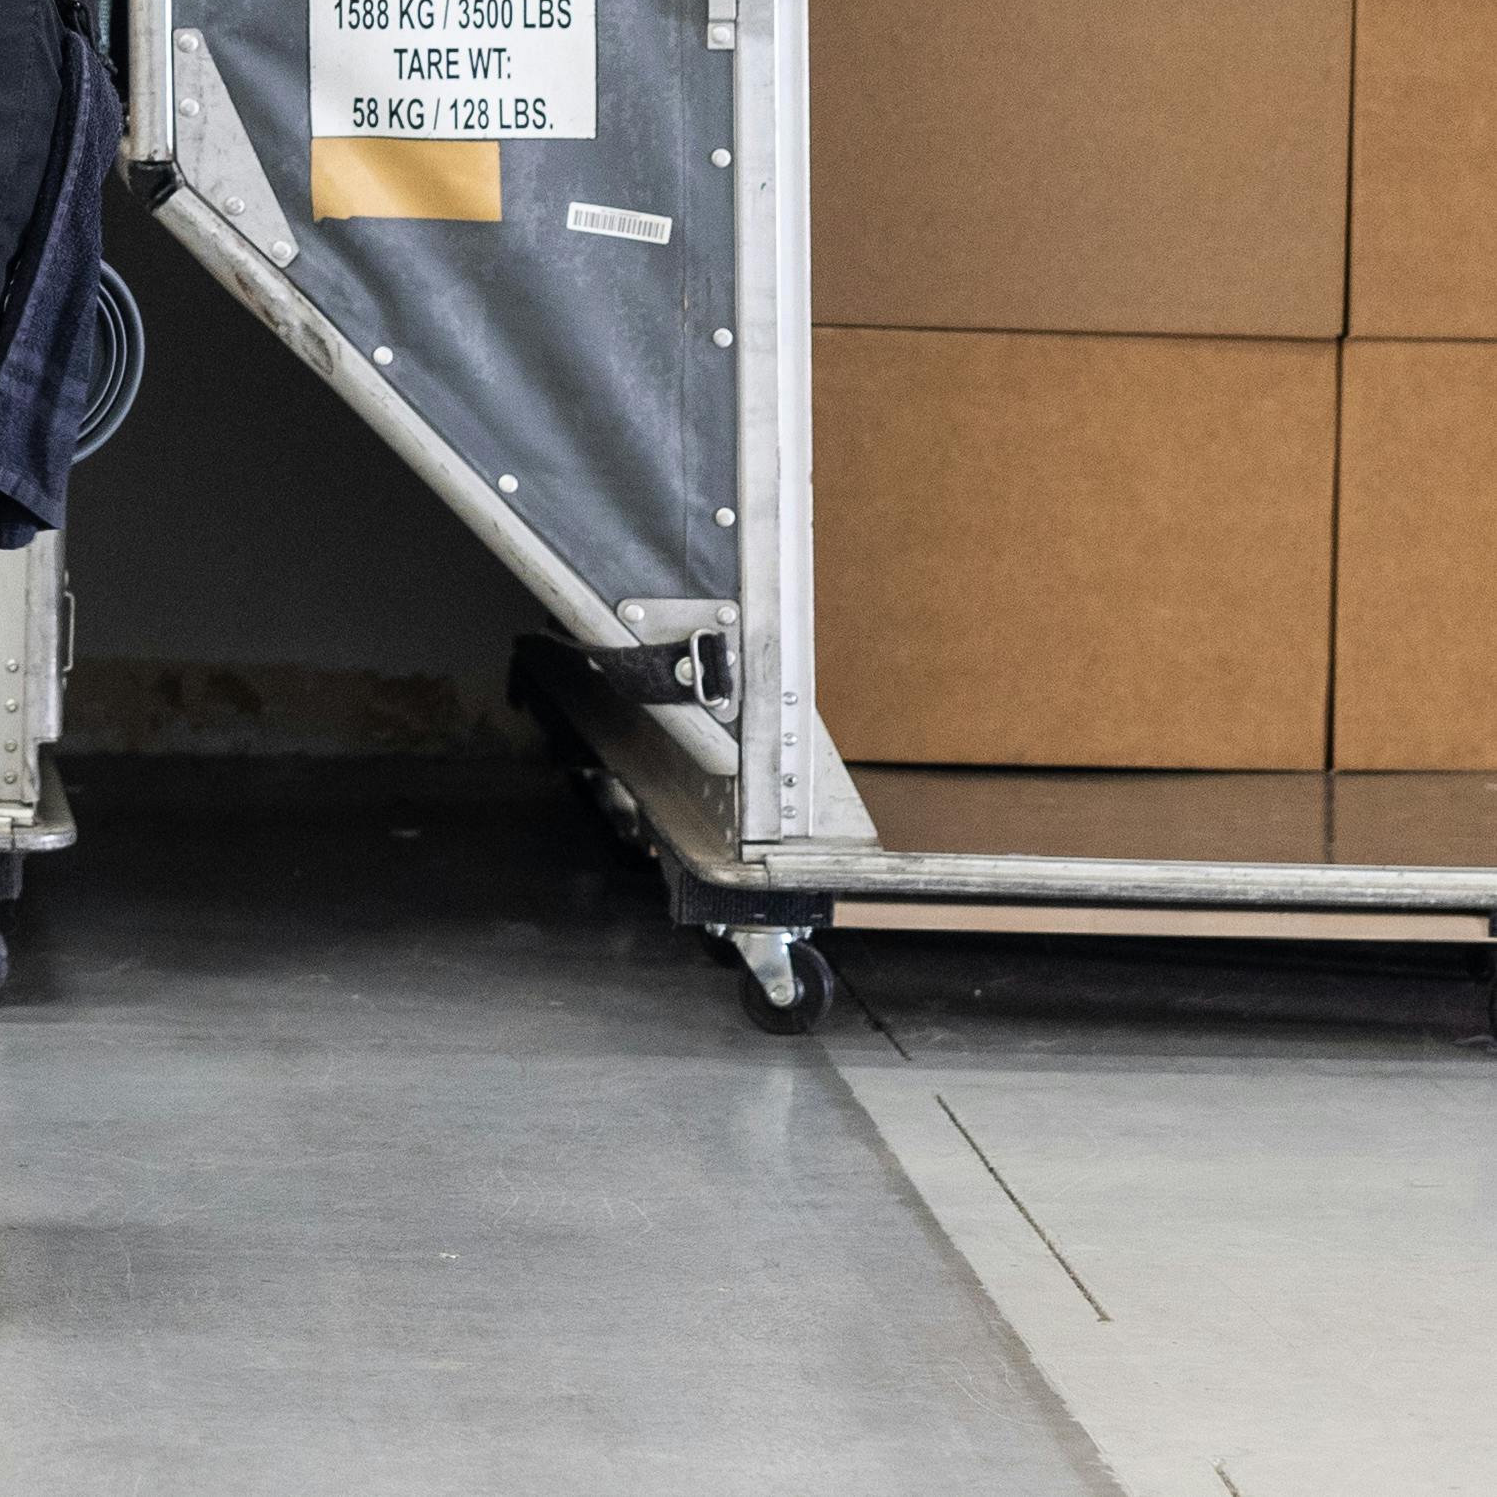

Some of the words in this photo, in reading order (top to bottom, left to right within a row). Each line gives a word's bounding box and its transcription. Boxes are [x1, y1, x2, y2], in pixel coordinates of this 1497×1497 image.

[394, 48, 460, 79] TARE
[468, 48, 512, 79] WT:
[352, 97, 379, 129] 58
[388, 98, 425, 129] KG
[433, 97, 440, 130] /
[449, 97, 490, 129] 128
[498, 98, 554, 130] LBS.
